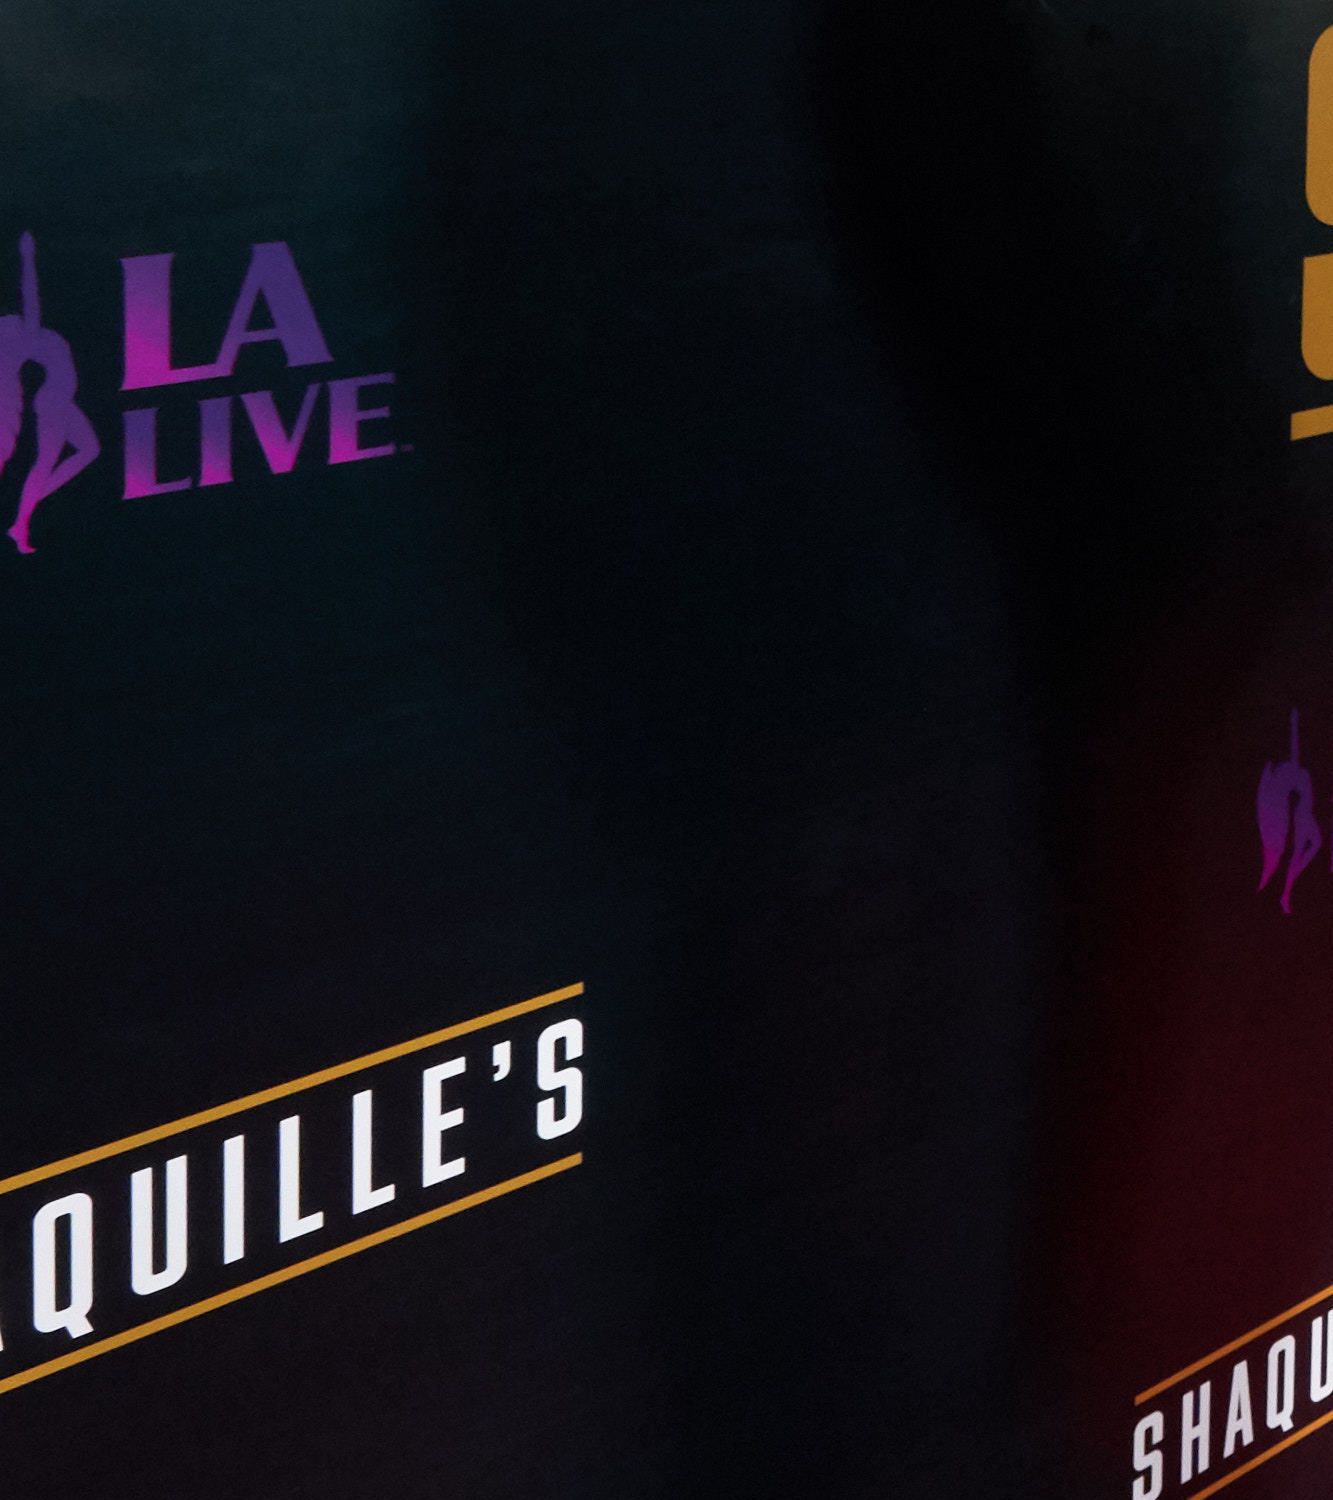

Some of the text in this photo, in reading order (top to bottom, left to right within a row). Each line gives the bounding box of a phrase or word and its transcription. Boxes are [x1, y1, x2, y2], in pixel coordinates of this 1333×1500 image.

[120, 241, 334, 391] LA
[121, 372, 396, 501] LIVE
[0, 1018, 584, 1352] QUILLE'S
